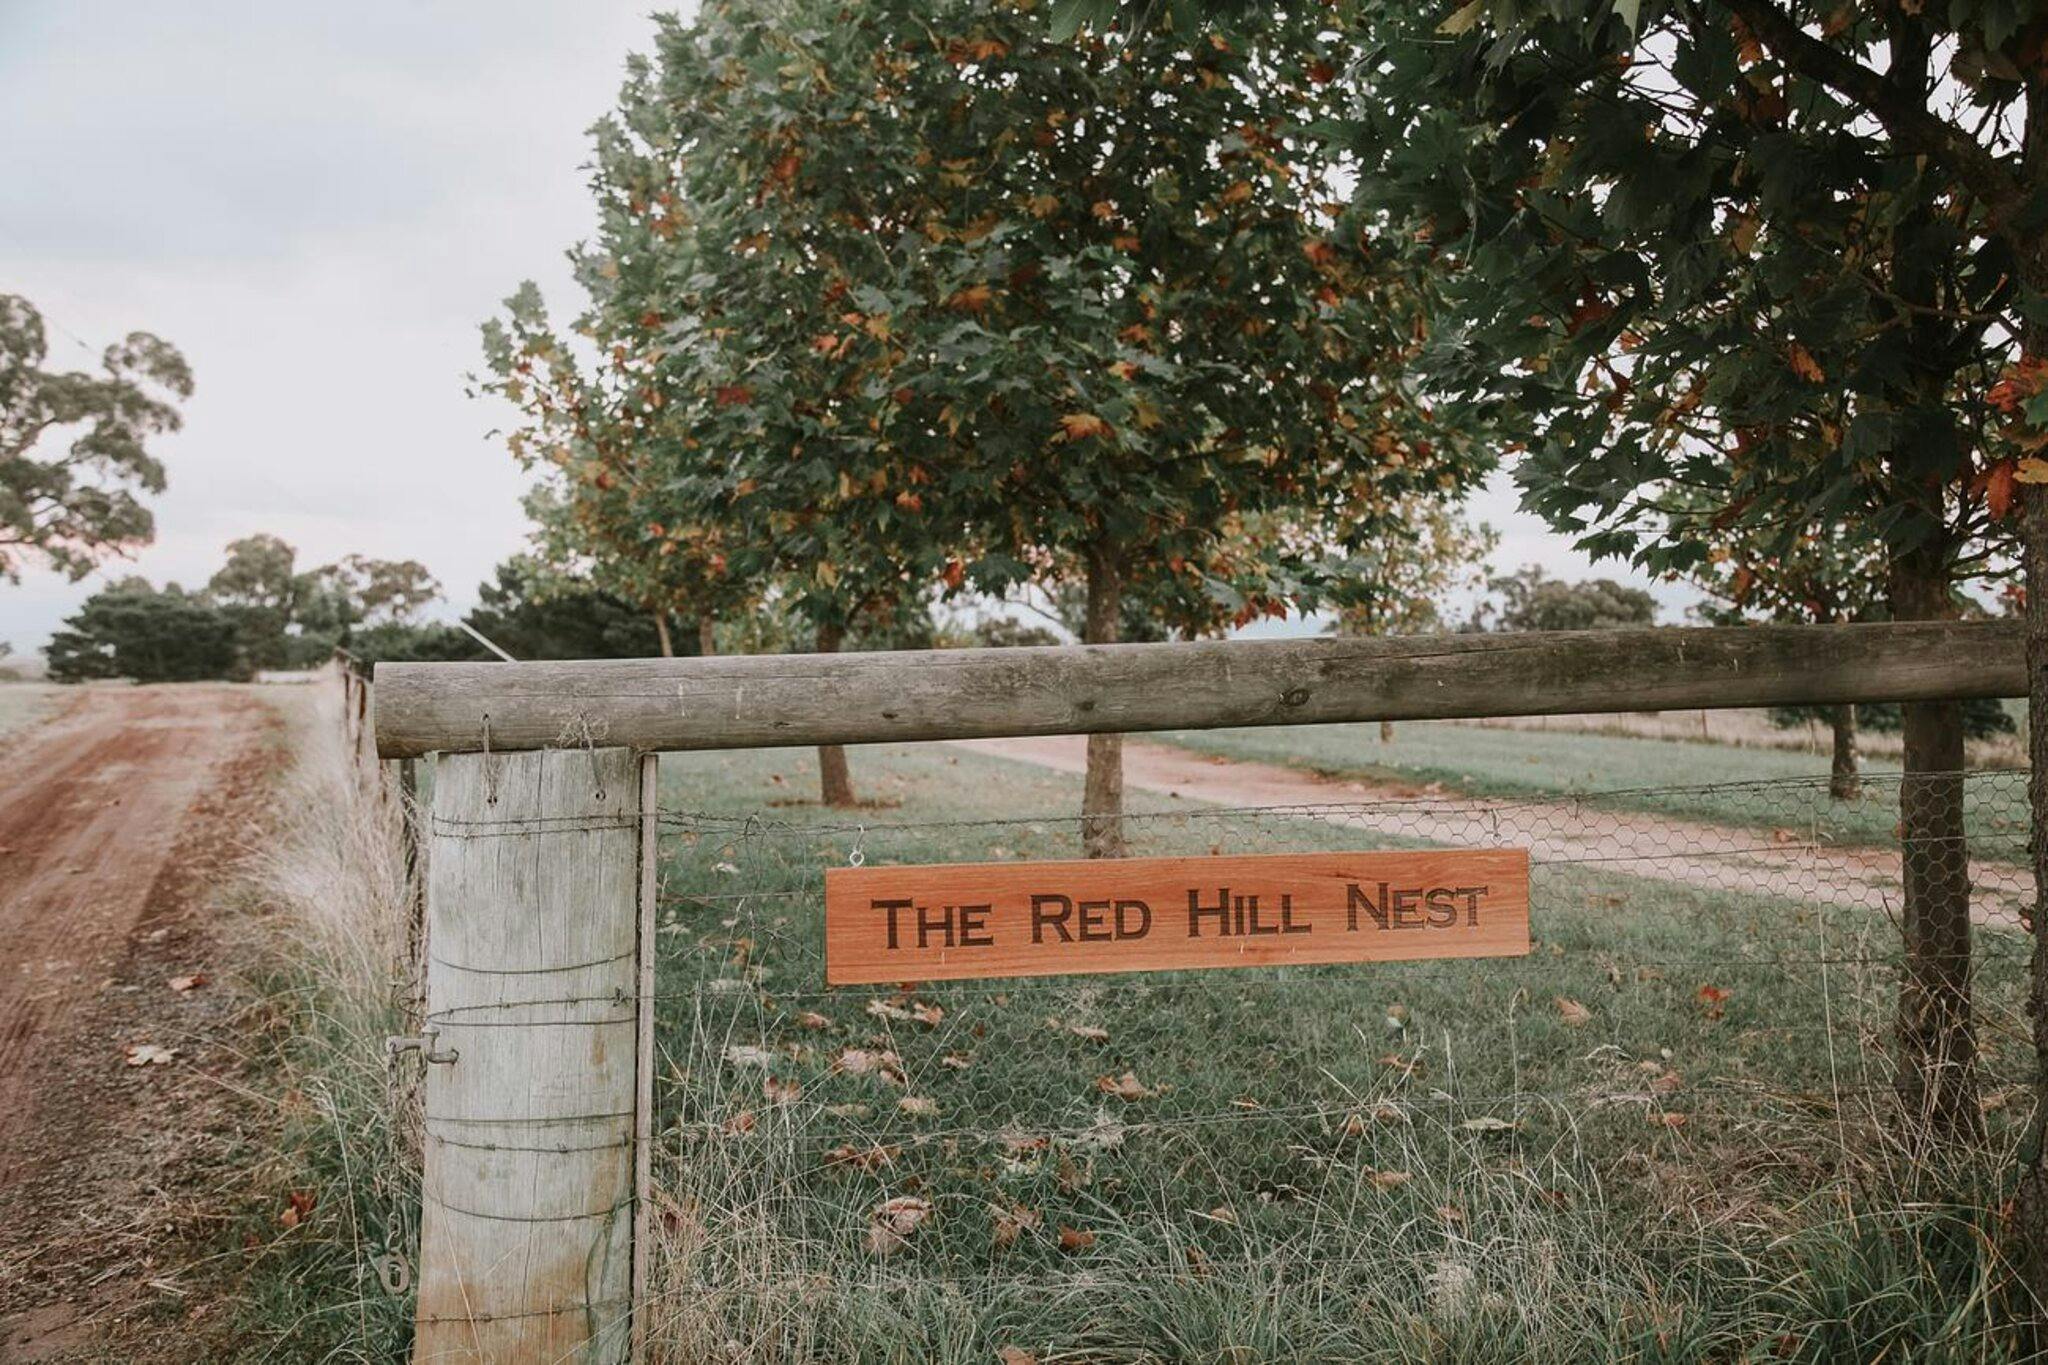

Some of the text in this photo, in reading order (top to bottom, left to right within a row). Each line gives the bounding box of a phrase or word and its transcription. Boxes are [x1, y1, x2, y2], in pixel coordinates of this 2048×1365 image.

[871, 882, 1489, 949] THE RED HILL NEST
